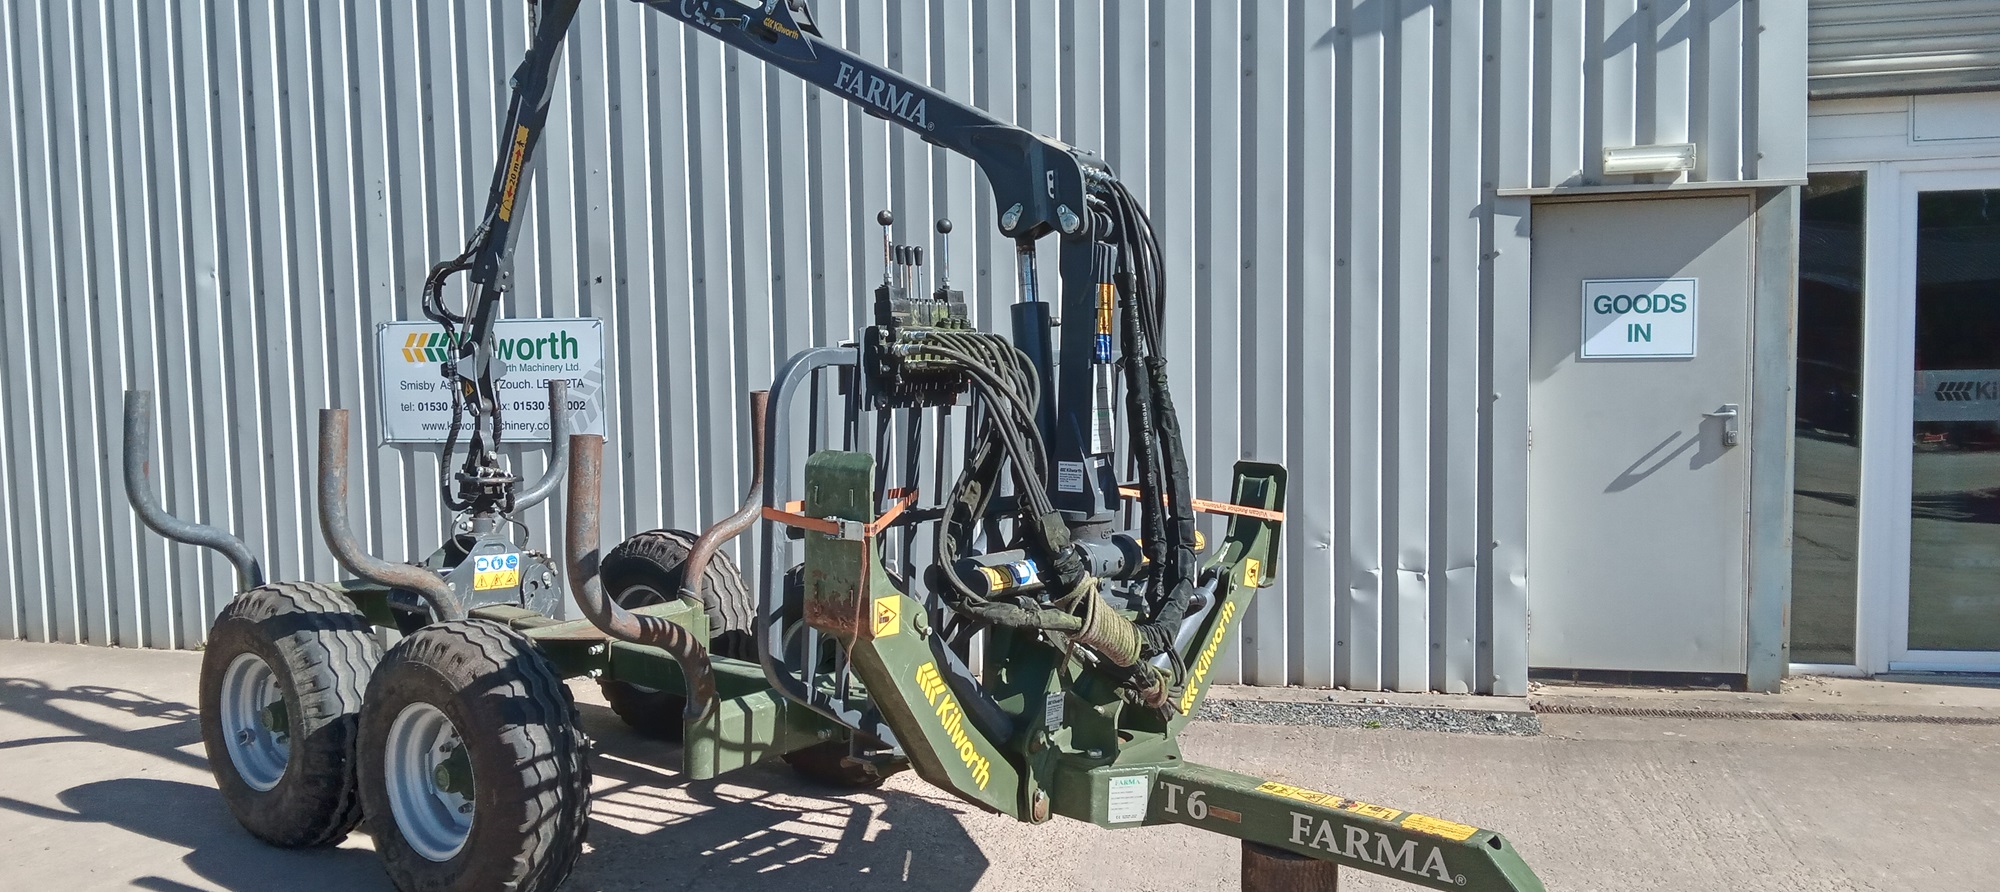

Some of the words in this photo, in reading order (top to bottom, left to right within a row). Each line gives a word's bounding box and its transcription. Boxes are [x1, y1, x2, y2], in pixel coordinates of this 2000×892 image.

[773, 21, 799, 40] Kilworth
[510, 173, 516, 186] 20
[1593, 293, 1687, 315] GOODS
[1627, 323, 1652, 342] IN
[519, 363, 563, 373] Machinery
[565, 363, 581, 371] Ltd.
[400, 380, 435, 392] Smisby
[499, 379, 534, 389] Zouch.
[401, 402, 415, 412] tel:
[417, 402, 448, 412] 01530
[513, 401, 544, 411] 01530
[1227, 506, 1249, 514] Anchor
[1249, 509, 1268, 517] Vulcan
[1194, 600, 1236, 683] Kilworth
[935, 693, 990, 791] Kilworth
